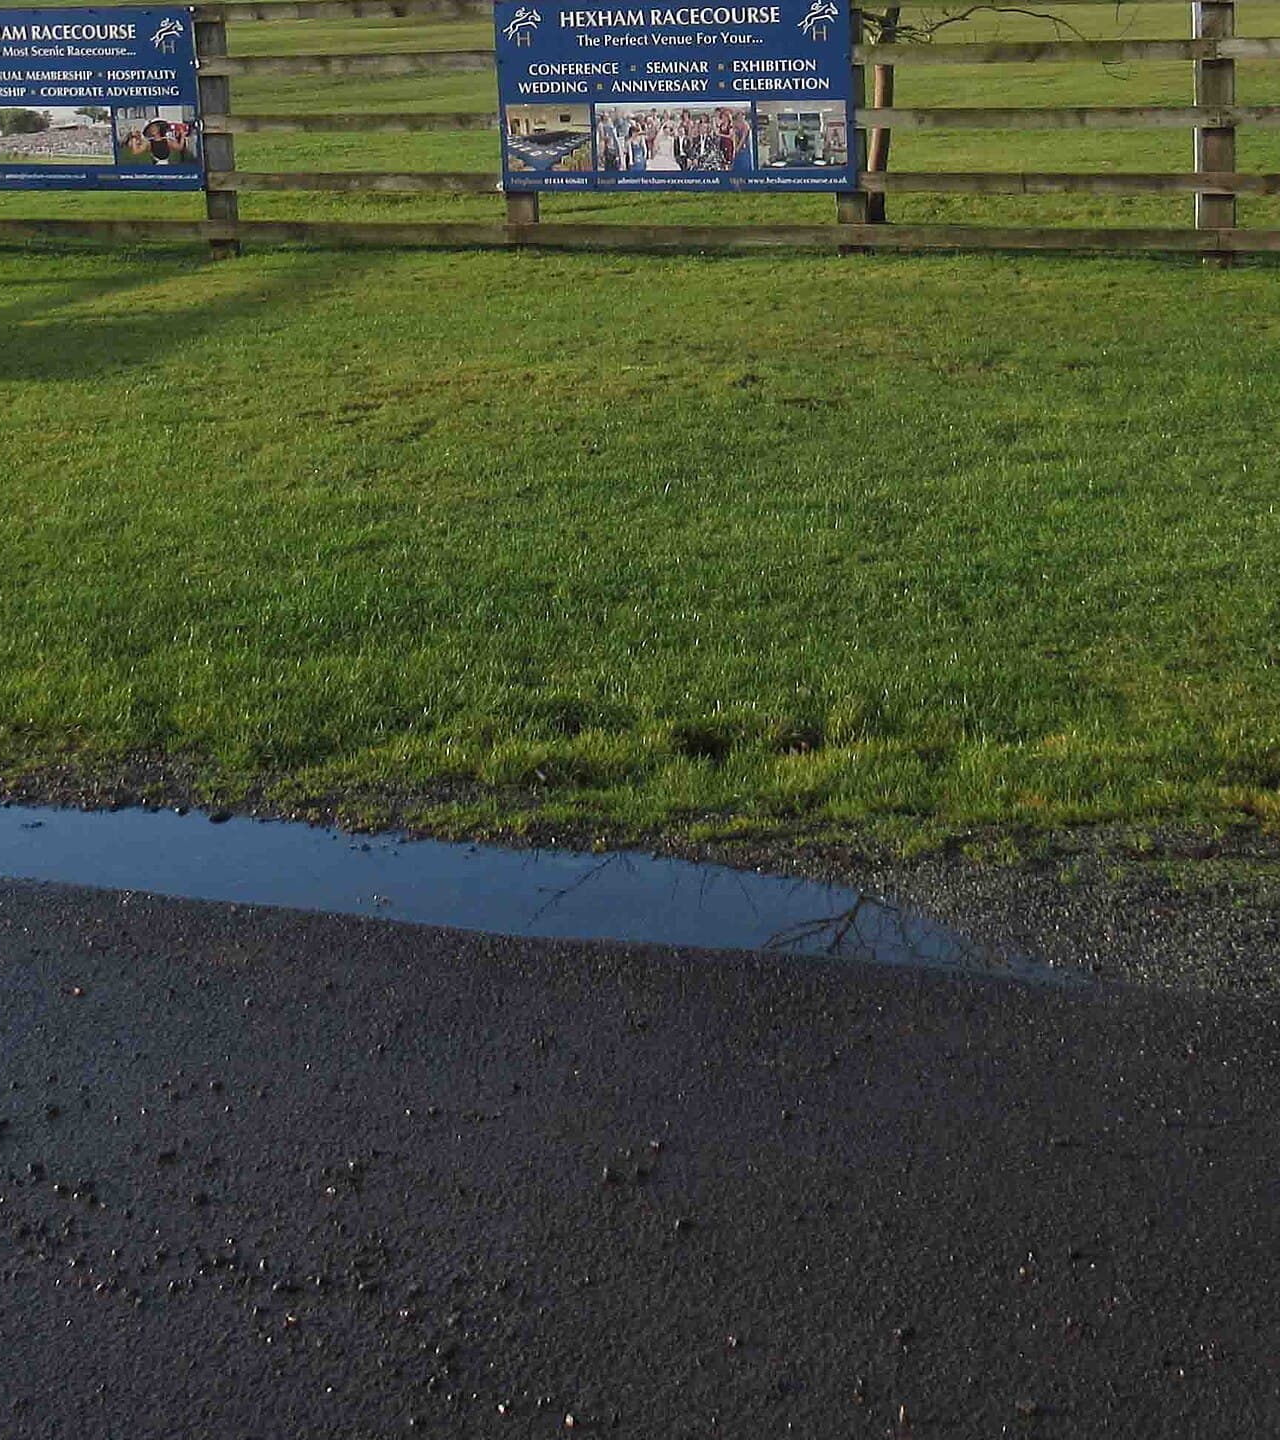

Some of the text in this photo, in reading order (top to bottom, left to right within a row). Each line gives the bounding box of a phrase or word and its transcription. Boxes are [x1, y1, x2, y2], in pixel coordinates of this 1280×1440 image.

[559, 6, 781, 28] HEXHAM RACECOURSE
[31, 23, 137, 40] RACECOURSE
[576, 31, 764, 47] The Perfect Venue For Your...
[2, 46, 29, 57] Most
[31, 45, 65, 57] Scenic
[67, 45, 137, 57] Racecourse...
[26, 70, 93, 81] MEMBERSHIP
[107, 69, 177, 80] HOSPITALITY
[528, 59, 817, 76] CONFERENCE SEMINAR EXHIBITION
[40, 86, 104, 97] CORPORATE
[106, 85, 180, 97] ADVERTISING
[518, 77, 830, 94] WEDDING ANNIVERSARY CELEBRATION
